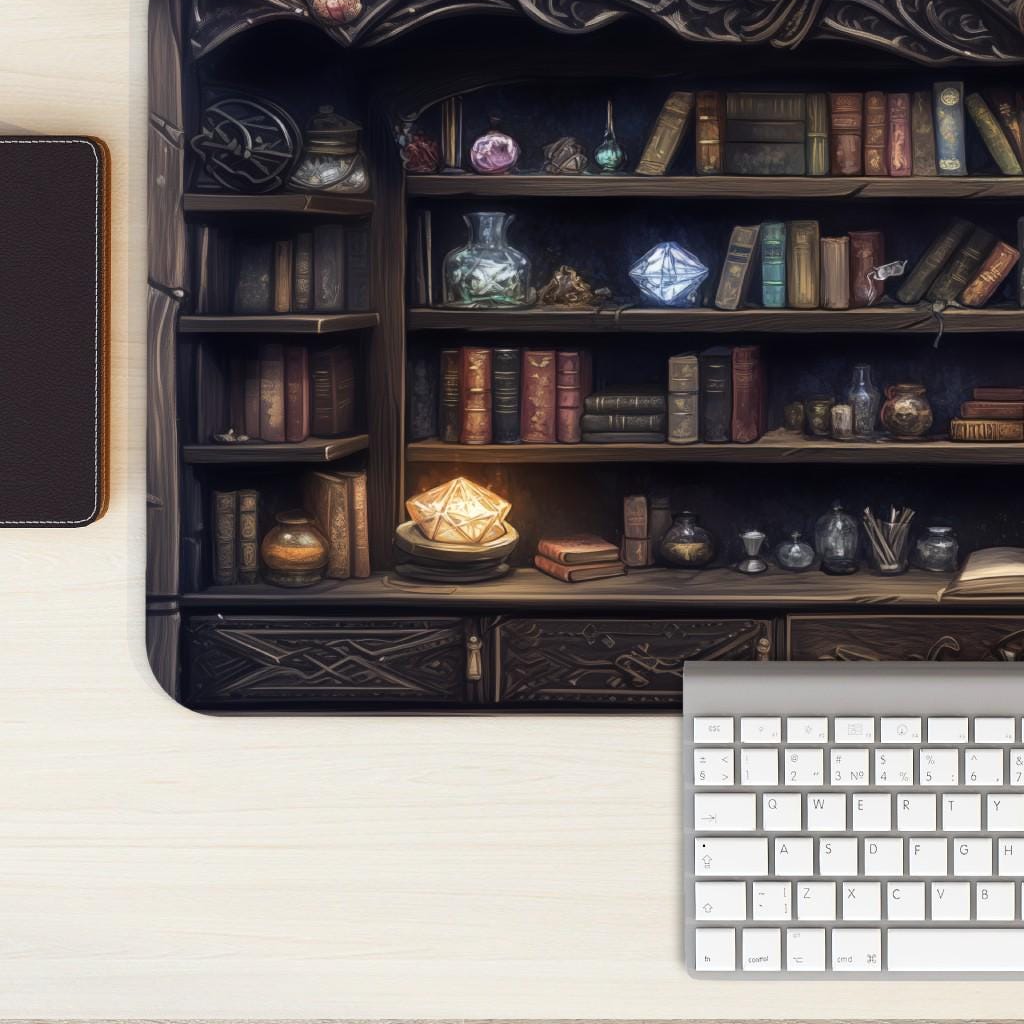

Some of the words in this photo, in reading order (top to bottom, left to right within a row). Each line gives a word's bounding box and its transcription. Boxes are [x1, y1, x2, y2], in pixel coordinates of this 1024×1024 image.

[790, 753, 799, 763] @
[1015, 756, 1024, 766] &
[790, 770, 797, 782] 2
[834, 770, 842, 782] 3
[880, 770, 887, 781] 4
[970, 771, 977, 782] 6
[1015, 771, 1023, 783] 7
[767, 798, 778, 810] Q
[812, 798, 825, 810] W
[857, 799, 864, 811] E
[903, 799, 910, 811] R
[947, 800, 955, 812] T
[993, 800, 1001, 811] Y
[779, 843, 789, 855] A
[825, 843, 832, 855] S
[869, 842, 878, 855] D
[914, 844, 921, 856] F
[959, 844, 969, 856] G
[1004, 844, 1013, 856] H
[803, 887, 812, 899] Z
[847, 888, 856, 899] X
[892, 888, 901, 900] C
[936, 888, 945, 900] V
[981, 888, 989, 900] B
[836, 955, 853, 964] cmd
